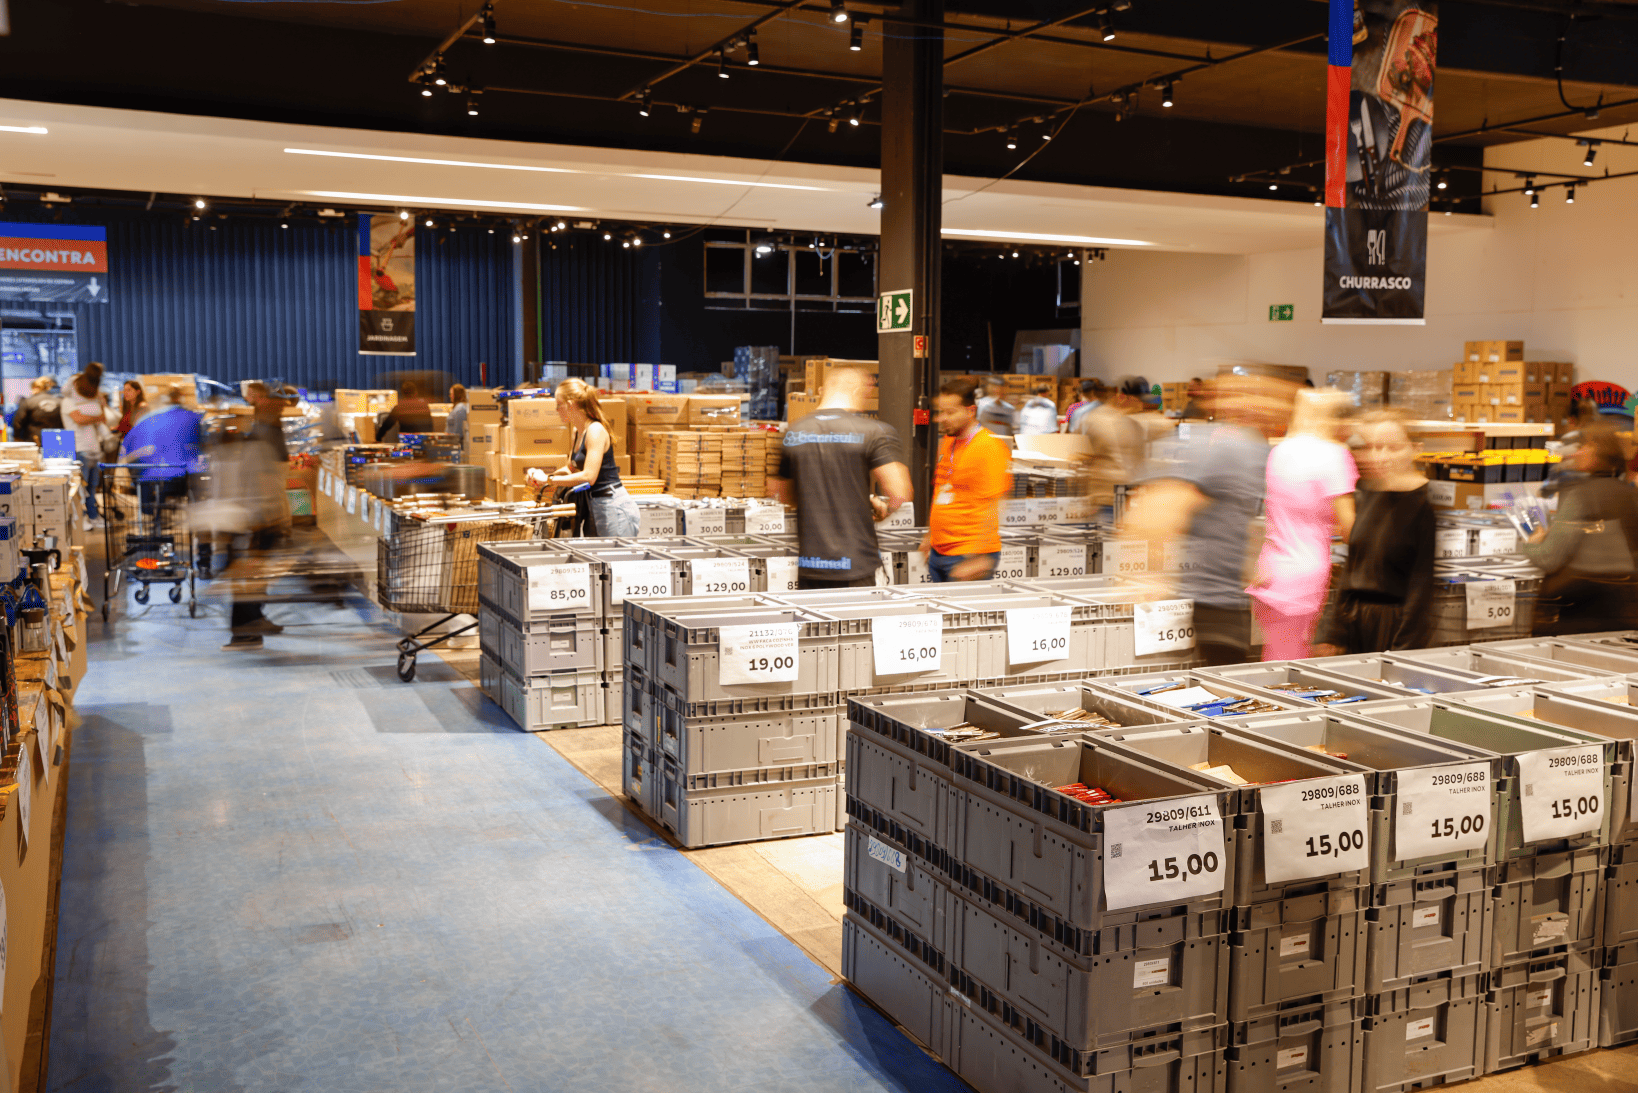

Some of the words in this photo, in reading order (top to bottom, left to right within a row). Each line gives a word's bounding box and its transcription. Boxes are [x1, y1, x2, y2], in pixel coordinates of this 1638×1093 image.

[1339, 276, 1411, 289] CHURRASCO
[649, 527, 674, 535] 33,00
[700, 525, 723, 535] 30,00
[759, 523, 782, 532] 20,00
[626, 585, 667, 597] 129,00
[705, 582, 746, 593] 129,00
[550, 589, 586, 601] 85,00
[1488, 606, 1510, 619] 5,00
[1158, 627, 1194, 642] 16,00
[1032, 637, 1066, 652] 16,00
[899, 646, 937, 662] 16,00
[749, 656, 794, 672] 19,00
[1548, 754, 1598, 768] 29809/688
[1432, 771, 1485, 786] 29809/688
[1564, 768, 1585, 776] TALHER
[1301, 784, 1360, 801] 29809/688
[1448, 787, 1470, 795] TALHER
[1320, 801, 1345, 810] TALHER
[1345, 798, 1361, 807] INOX
[1551, 795, 1599, 820] 15,00
[1146, 804, 1212, 824] 29809/611
[1169, 822, 1197, 832] TALHER
[1198, 819, 1216, 827] INOX
[1431, 814, 1484, 840] 15,00
[1305, 829, 1364, 858] 15,00
[1148, 851, 1219, 882] 15,00
